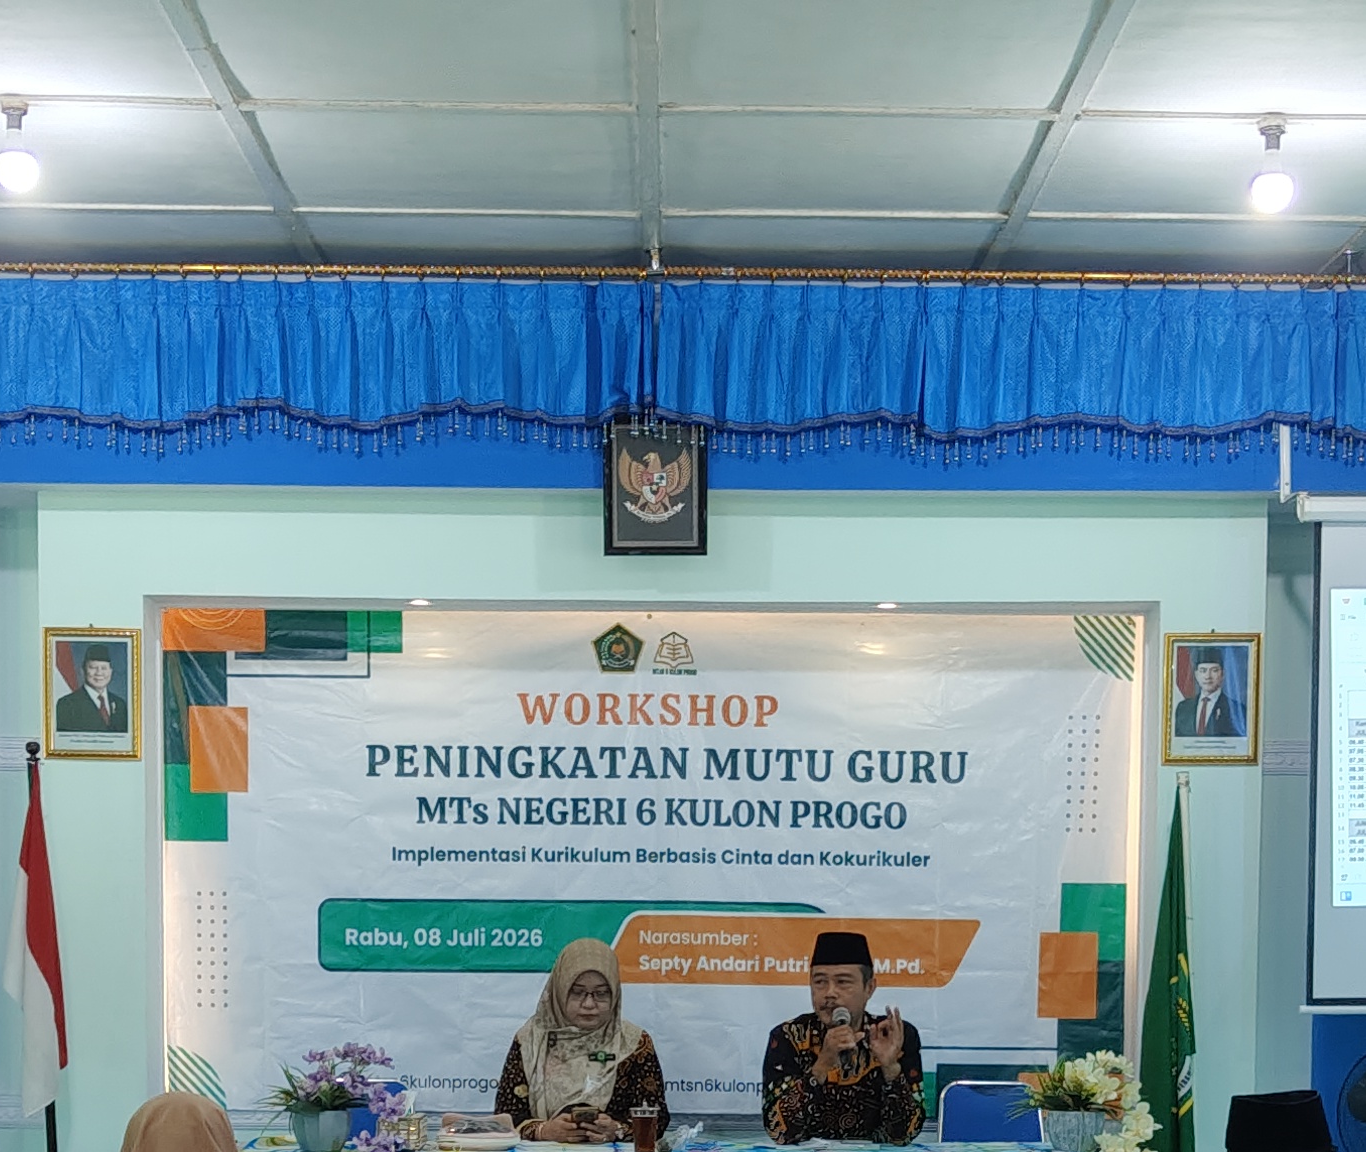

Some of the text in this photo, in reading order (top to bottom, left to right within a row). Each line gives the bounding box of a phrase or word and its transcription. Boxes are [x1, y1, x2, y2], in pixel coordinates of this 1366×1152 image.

[518, 694, 779, 728] WORKSHOP
[366, 745, 969, 785] PENINGKATAN MUTU GURU
[417, 797, 909, 831] MTs NEGERI 6 KULON PROGO
[392, 846, 932, 868] Implementasi Kurikulum Berbasis Cinta dan Kokurikuler
[345, 927, 544, 949] Rabu, 08 Juli 2026
[639, 930, 749, 946] Narasumber
[639, 955, 693, 976] Septy
[696, 956, 760, 973] Andari
[764, 957, 809, 973] Putri
